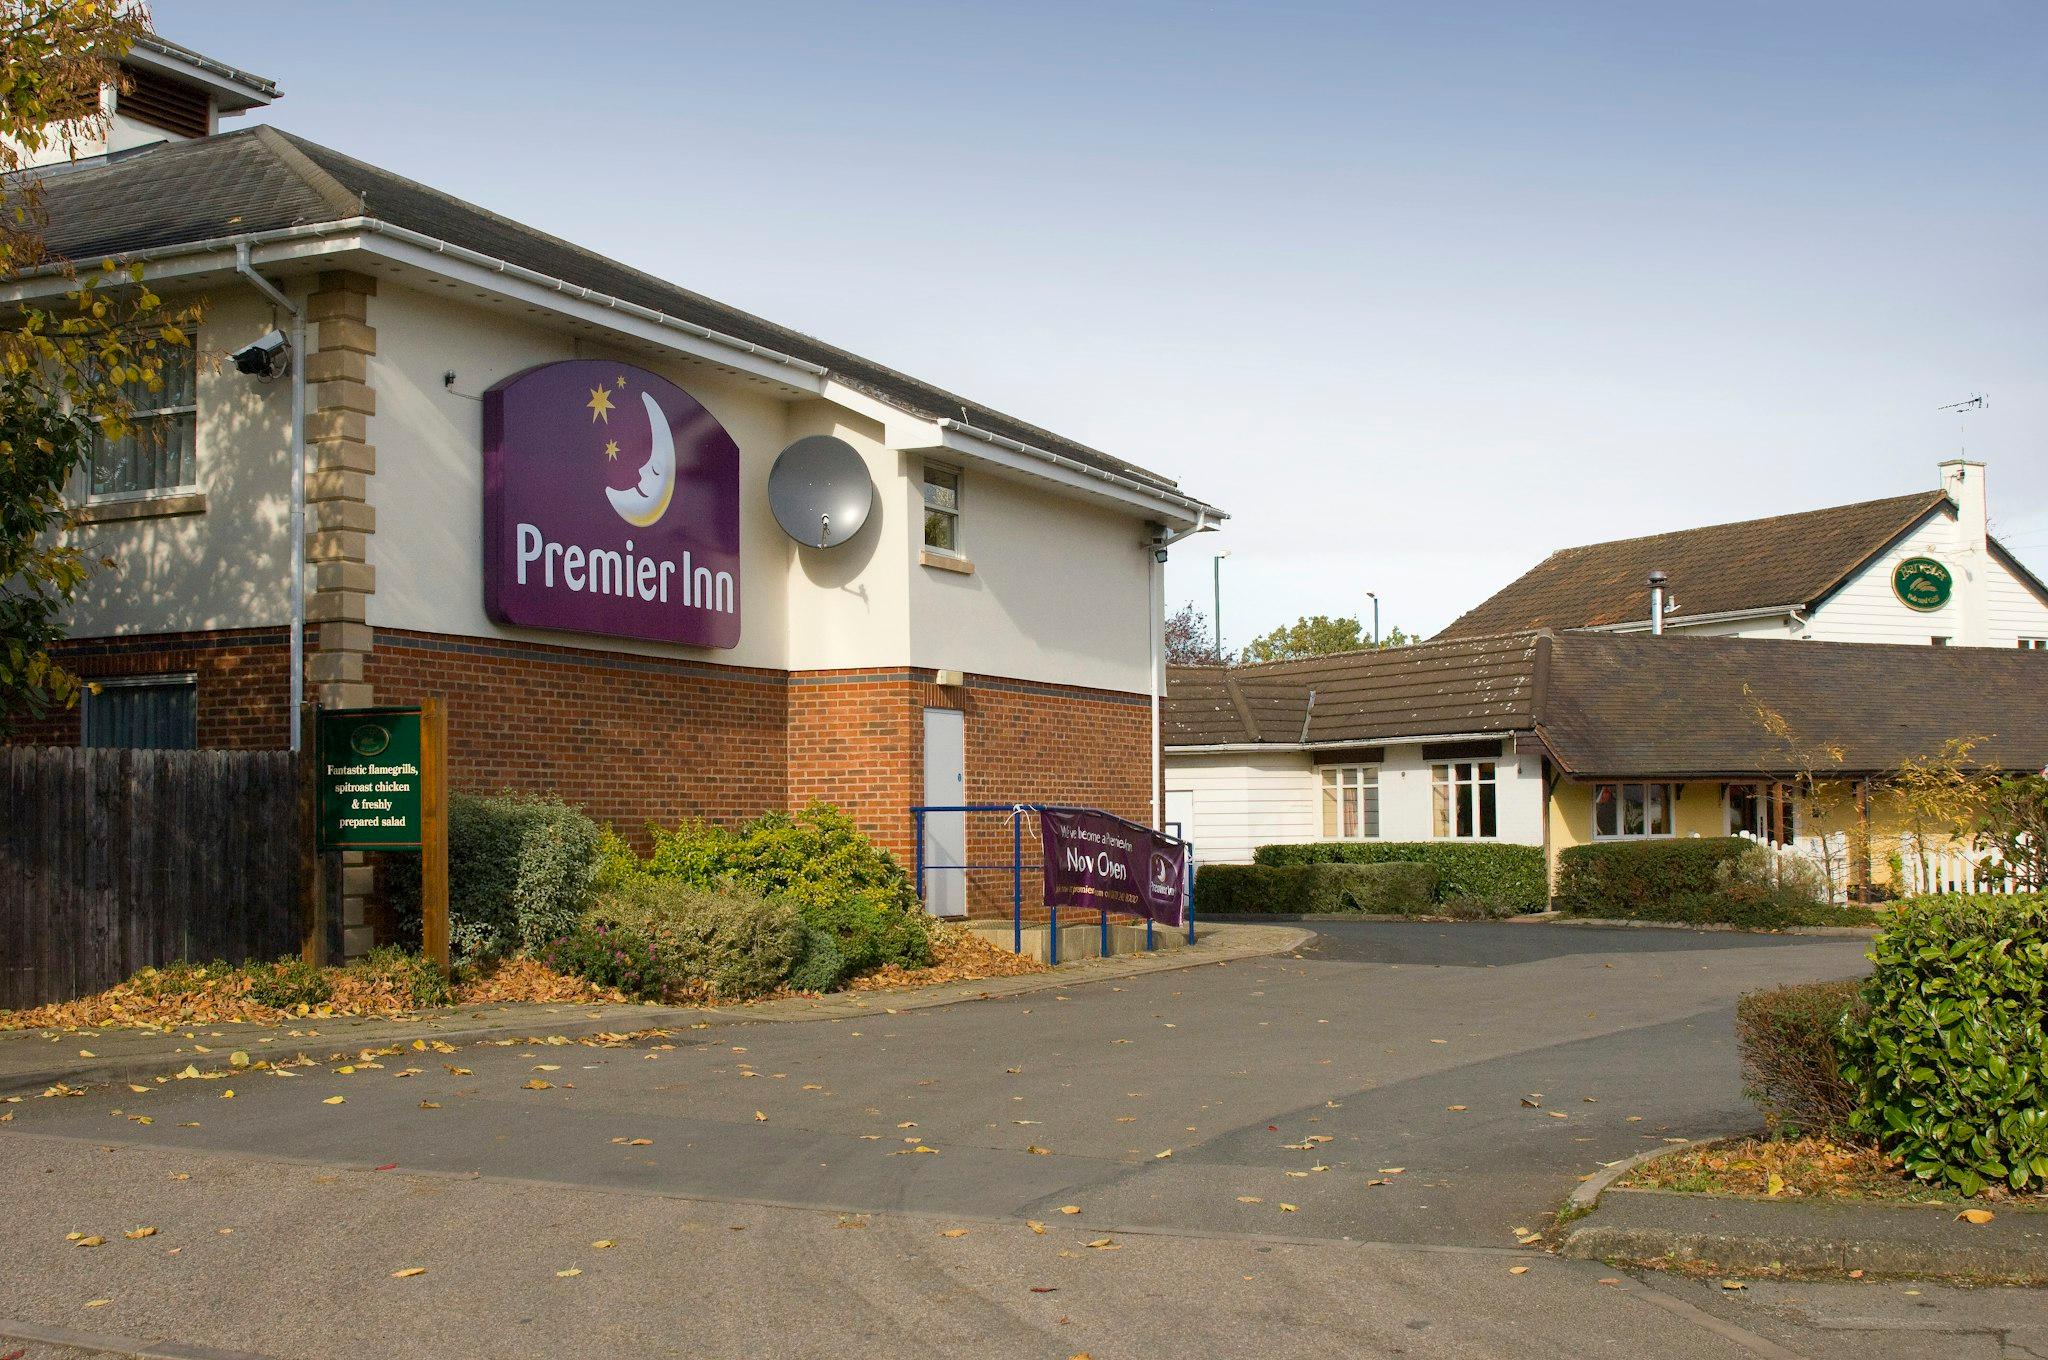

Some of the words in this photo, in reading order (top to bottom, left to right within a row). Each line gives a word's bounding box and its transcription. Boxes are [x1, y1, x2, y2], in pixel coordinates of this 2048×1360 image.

[517, 523, 675, 602] Premier
[683, 551, 734, 613] Inn
[327, 764, 367, 776] Fantastic
[368, 763, 418, 776] flamegrills,
[335, 782, 373, 794] spitroast
[375, 781, 410, 792] chicken
[351, 799, 359, 810] &
[362, 799, 392, 811] freshly
[339, 816, 379, 829] prepared
[382, 816, 406, 827] salad
[1077, 826, 1101, 843] beome
